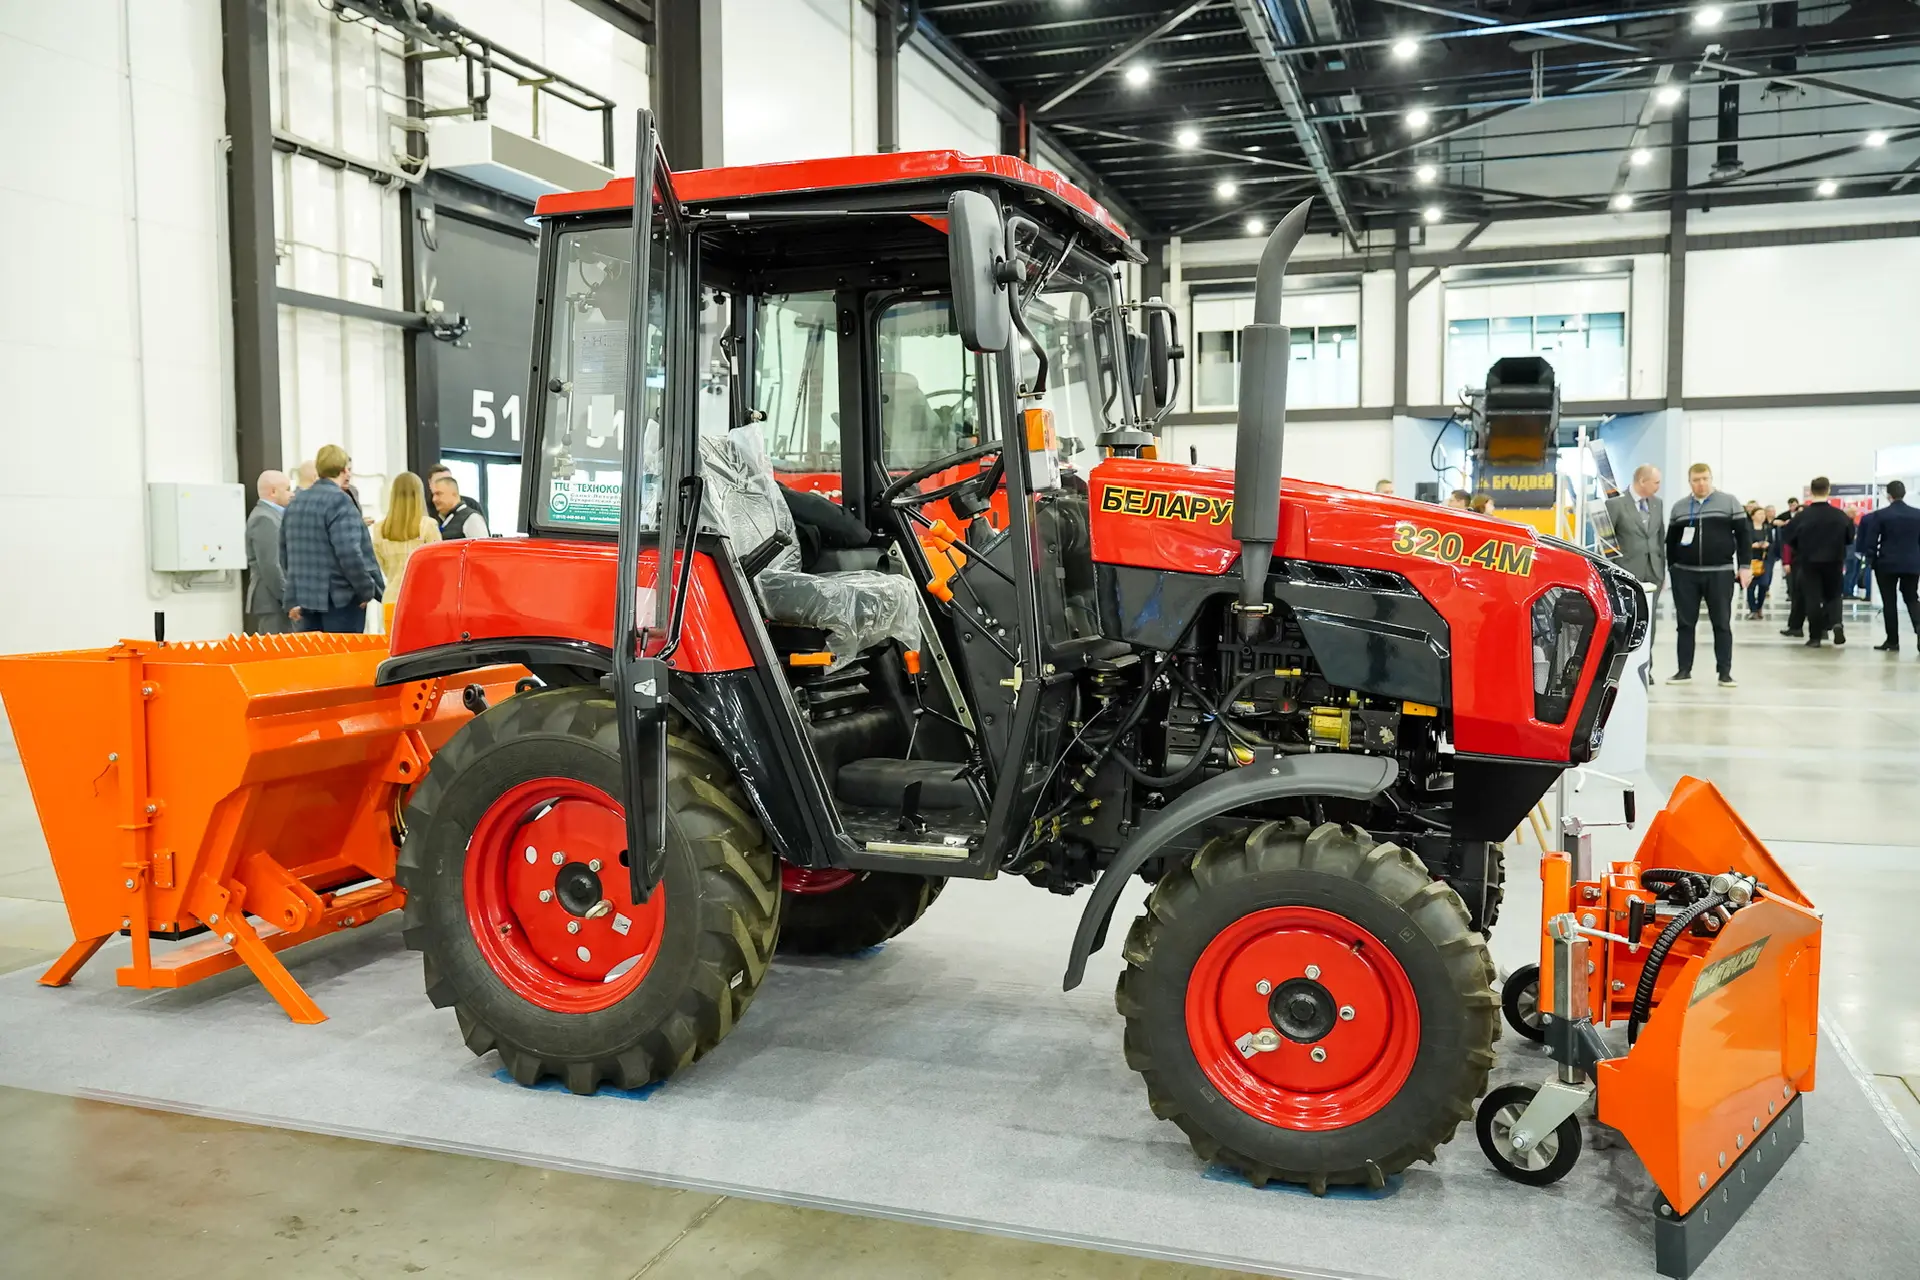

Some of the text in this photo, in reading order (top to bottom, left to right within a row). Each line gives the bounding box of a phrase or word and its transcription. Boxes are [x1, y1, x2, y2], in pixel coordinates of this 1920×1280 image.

[470, 389, 521, 442] 51
[1101, 484, 1234, 525] БЕЛАРУ
[1392, 523, 1536, 577] 320.4М
